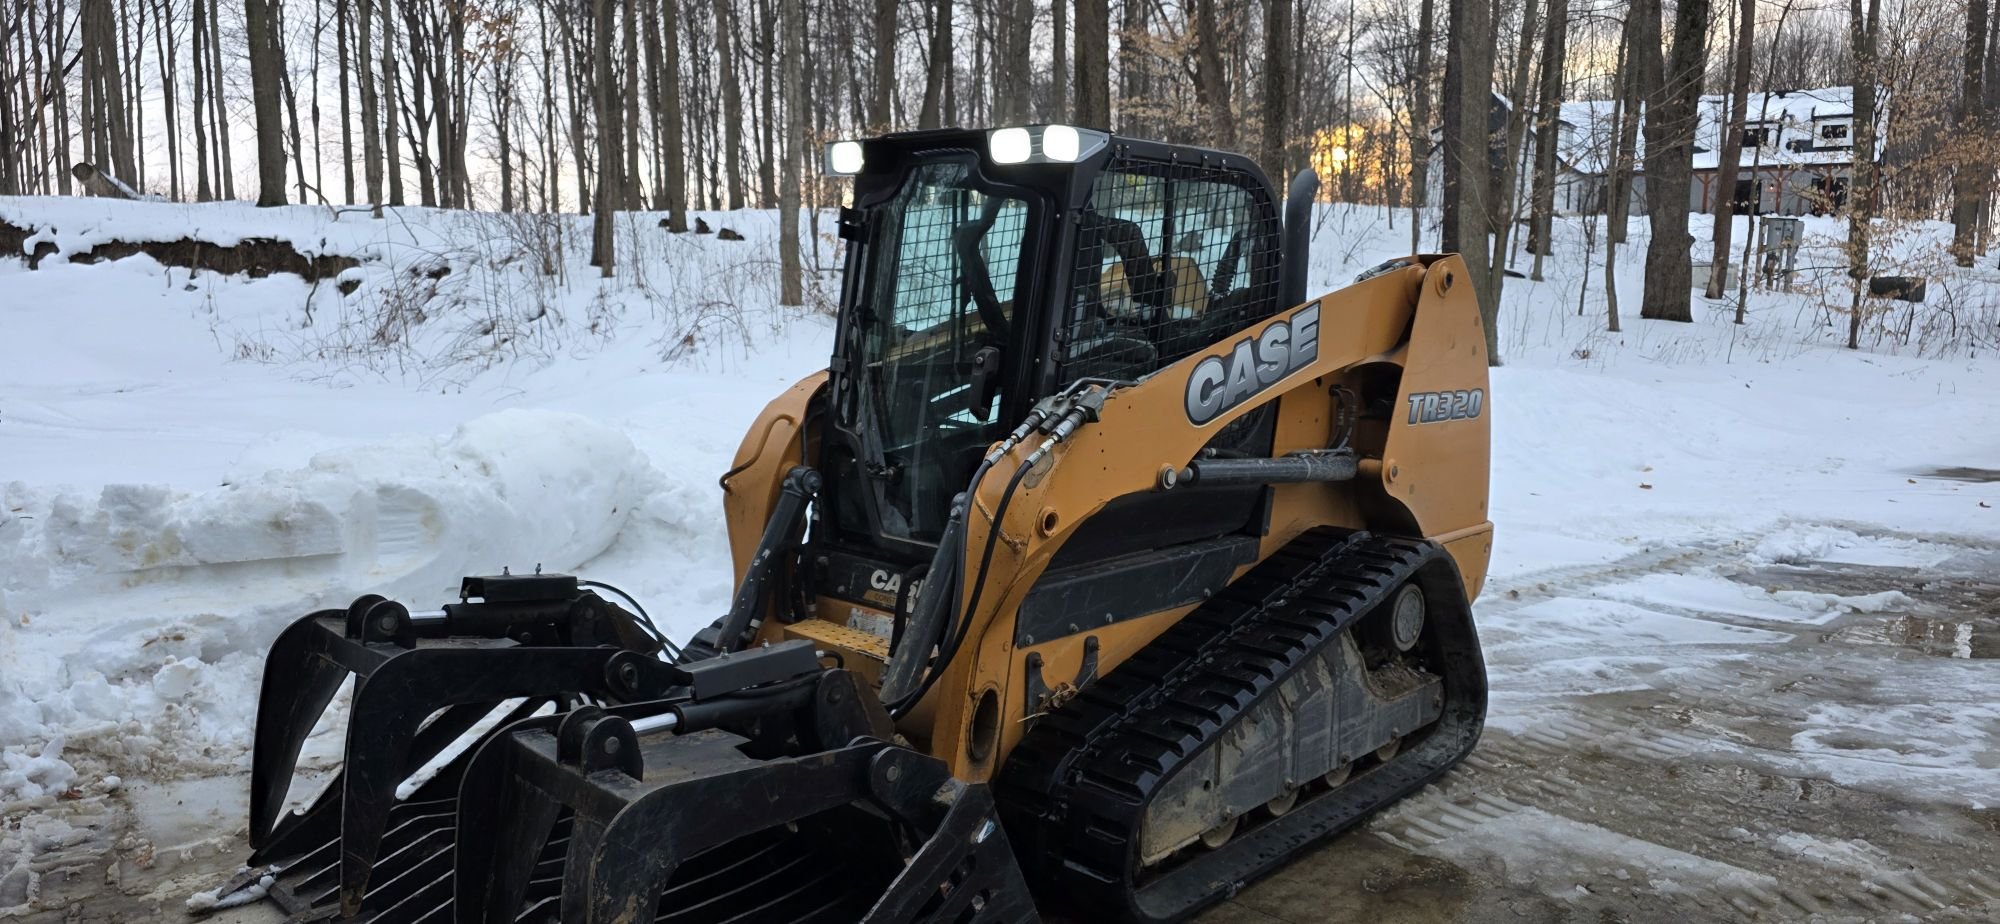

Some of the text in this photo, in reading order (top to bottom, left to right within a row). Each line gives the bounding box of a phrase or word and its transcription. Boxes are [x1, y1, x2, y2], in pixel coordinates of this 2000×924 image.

[1185, 301, 1320, 425] CASE
[1408, 388, 1483, 424] TR320
[871, 569, 924, 598] CAS
